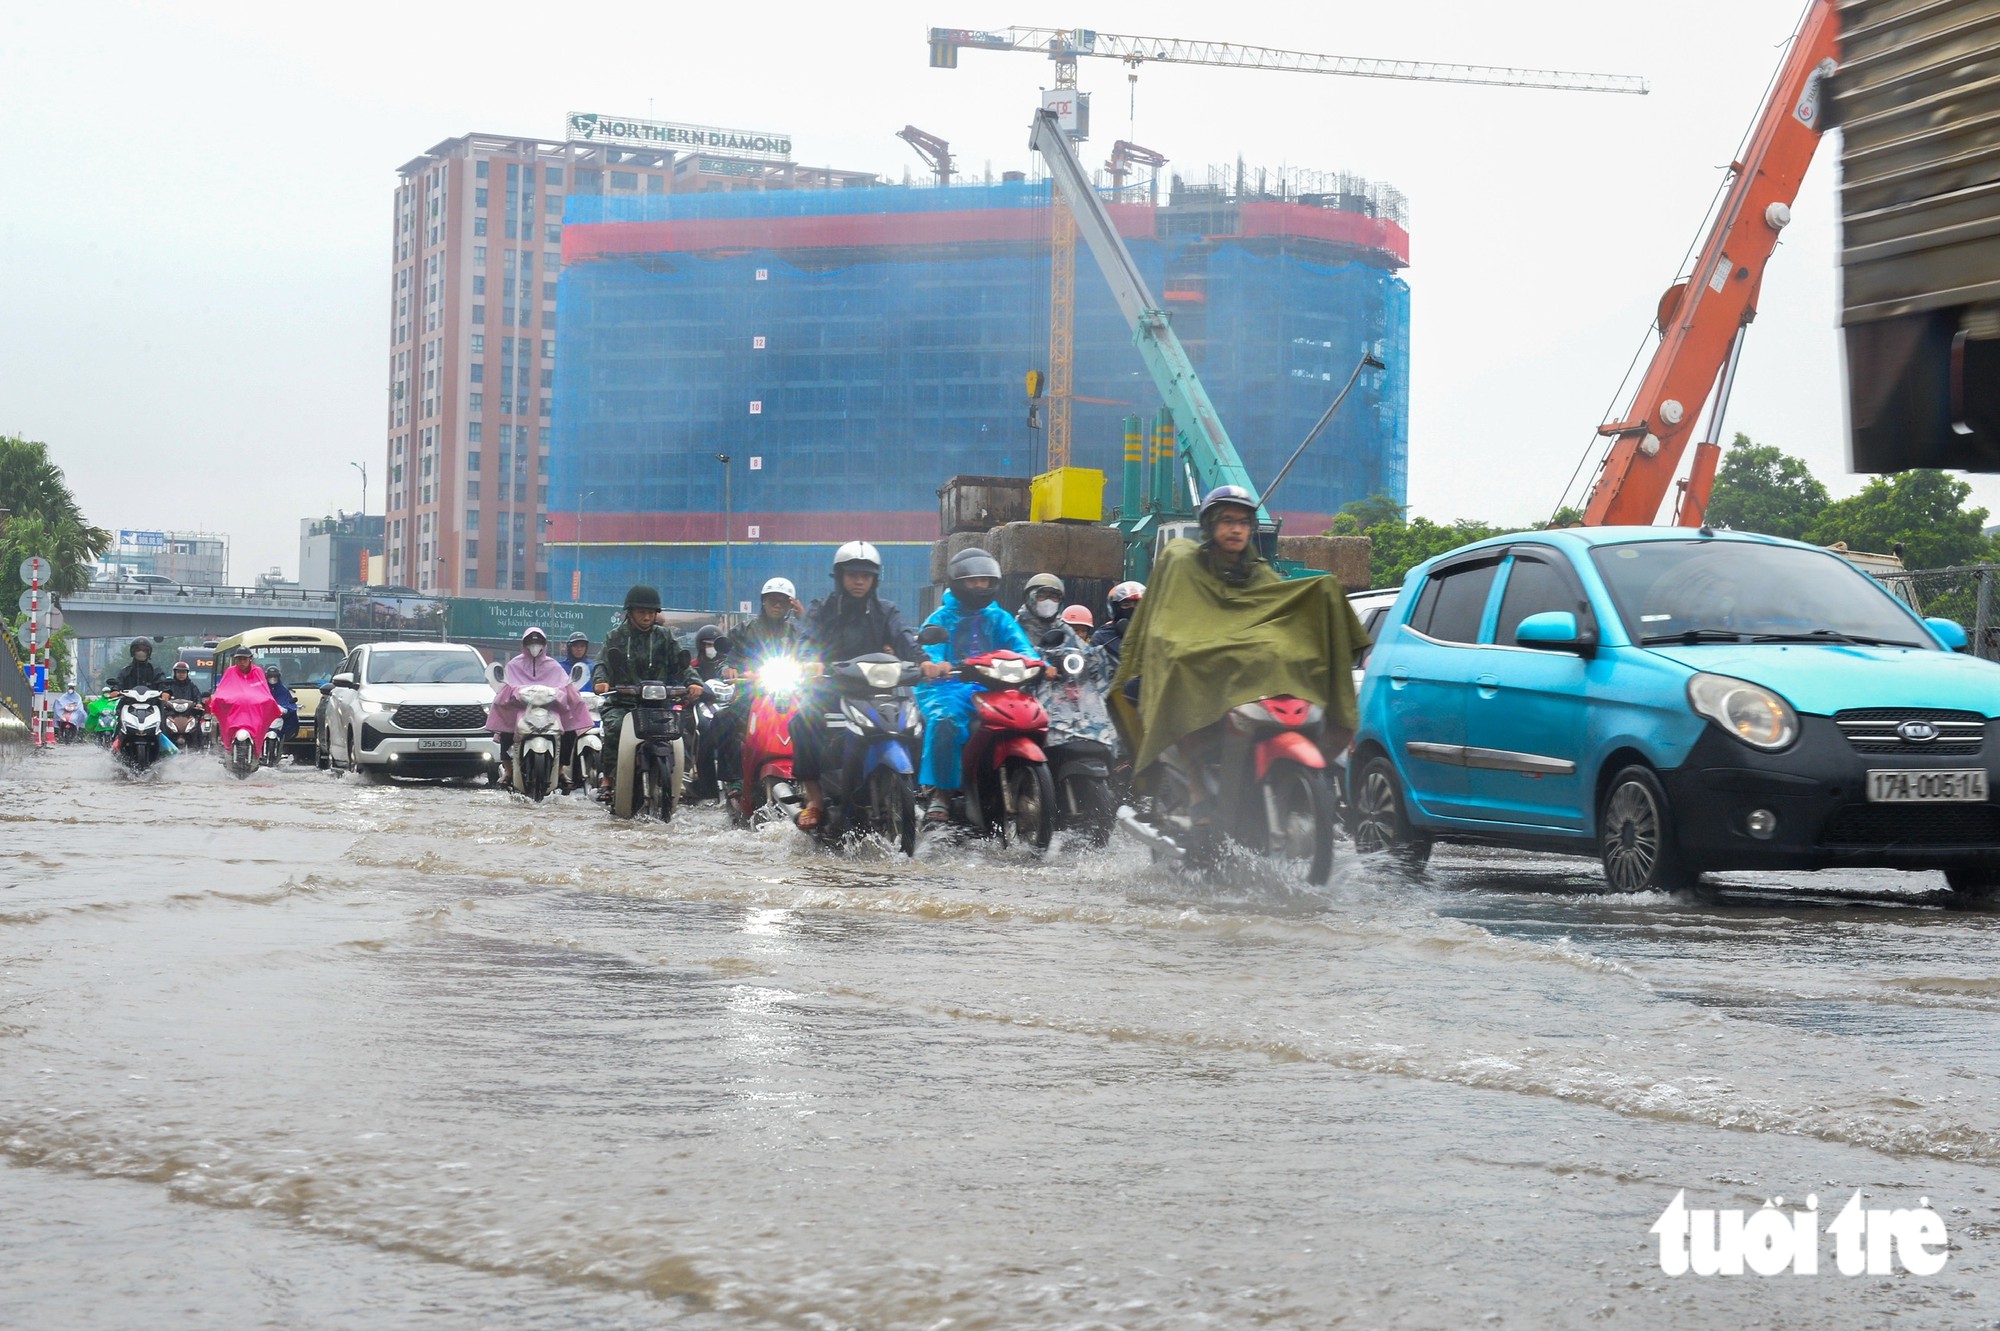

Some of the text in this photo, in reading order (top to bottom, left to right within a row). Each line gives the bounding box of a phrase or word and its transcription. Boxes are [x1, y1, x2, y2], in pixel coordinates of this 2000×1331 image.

[599, 120, 792, 154] NORTHERN DIAMOND
[755, 339, 764, 347] 12
[751, 403, 760, 411] 10
[489, 606, 508, 617] The
[510, 606, 534, 618] Lake
[1904, 725, 1933, 737] KIA
[1875, 773, 1985, 799] 17A-005.14
